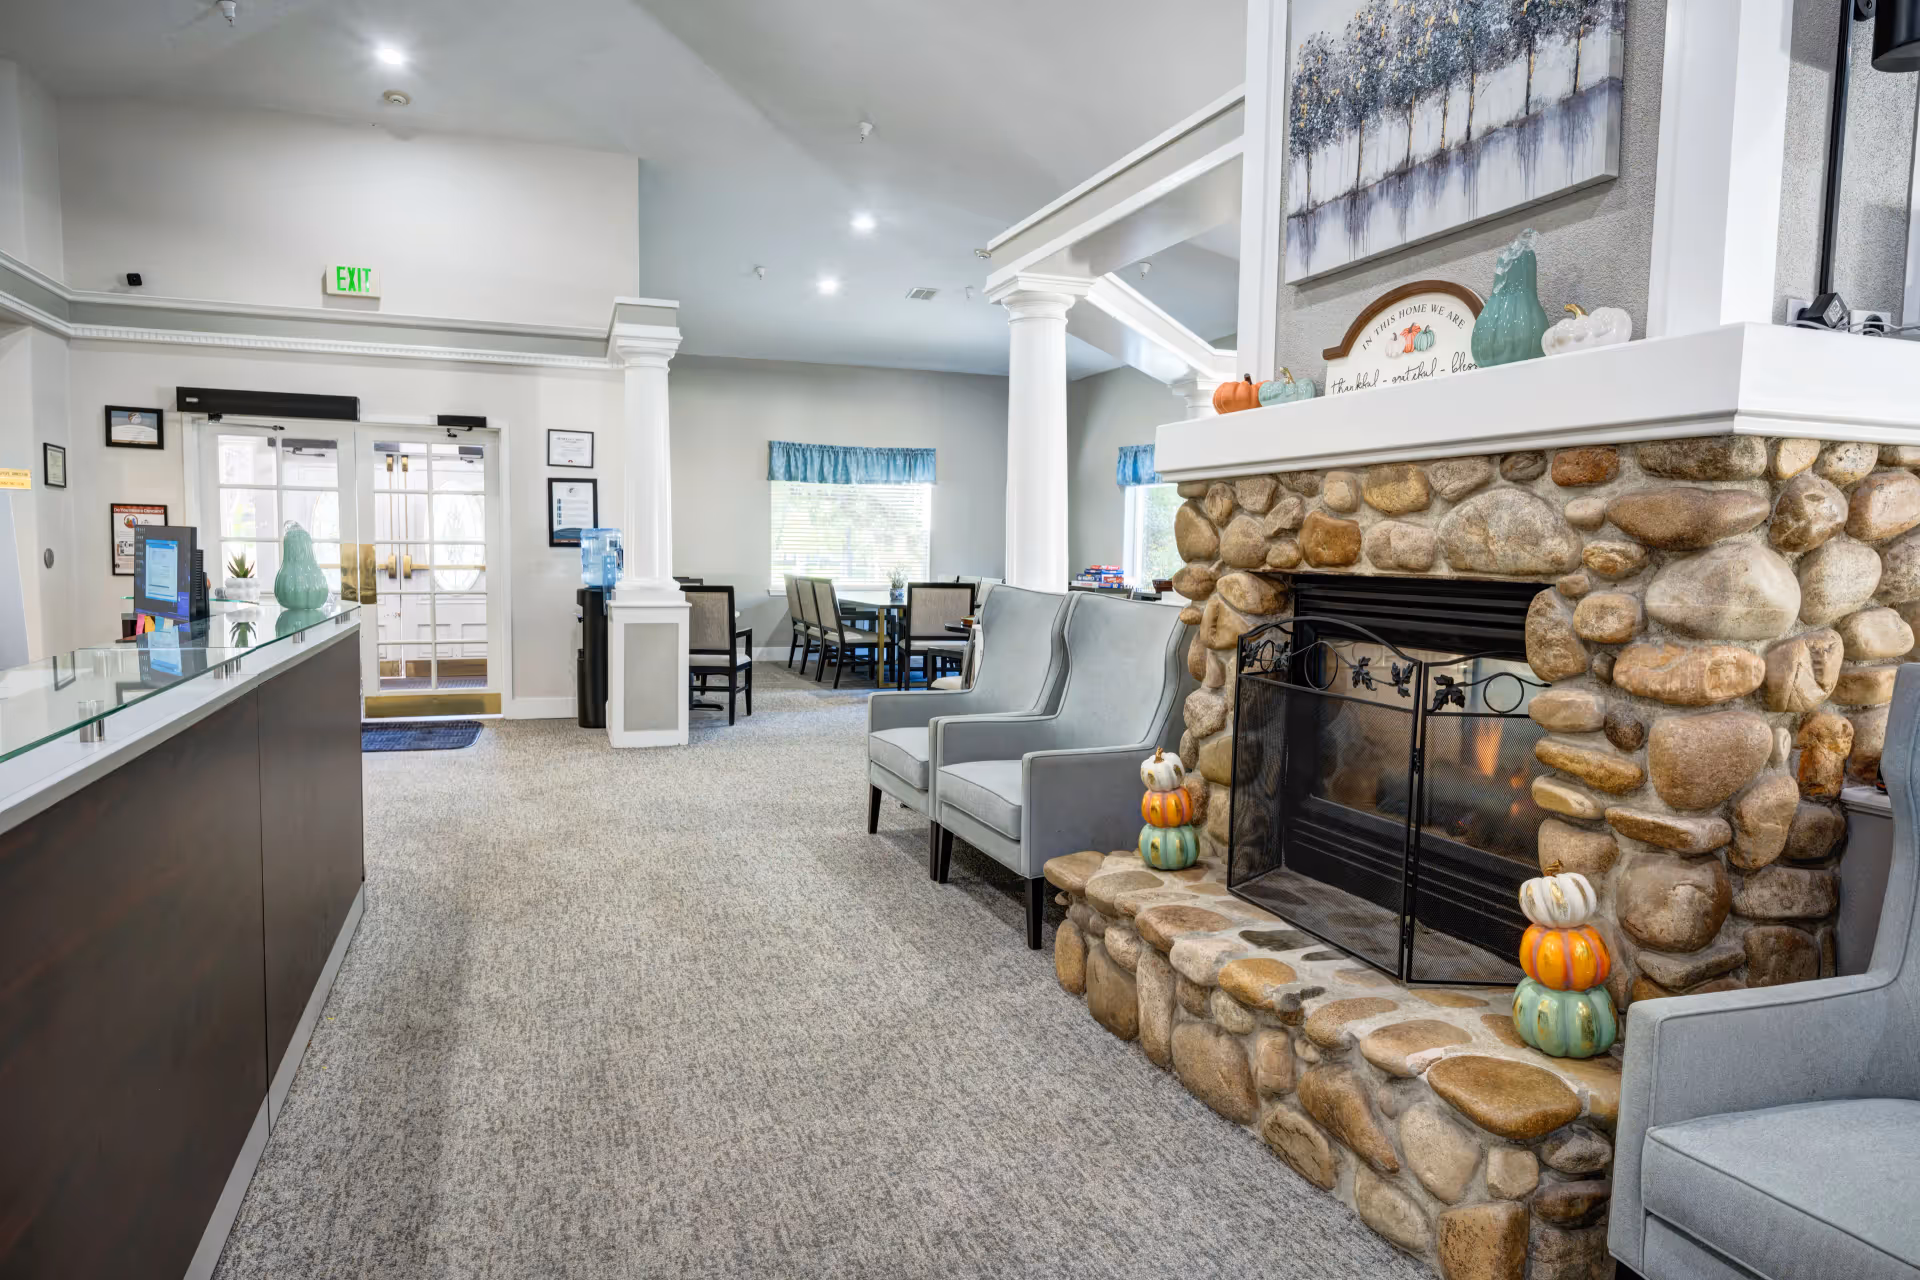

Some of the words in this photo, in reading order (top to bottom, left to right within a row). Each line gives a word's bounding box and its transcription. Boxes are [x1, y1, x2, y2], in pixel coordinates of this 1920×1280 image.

[336, 266, 371, 292] EXIT
[1362, 336, 1373, 351] IN
[1374, 314, 1396, 336] THIS
[1398, 304, 1428, 319] HOME
[1430, 303, 1446, 316] WE
[1446, 311, 1466, 330] ARE
[1331, 368, 1380, 395] thankful
[1391, 357, 1438, 384] grateful
